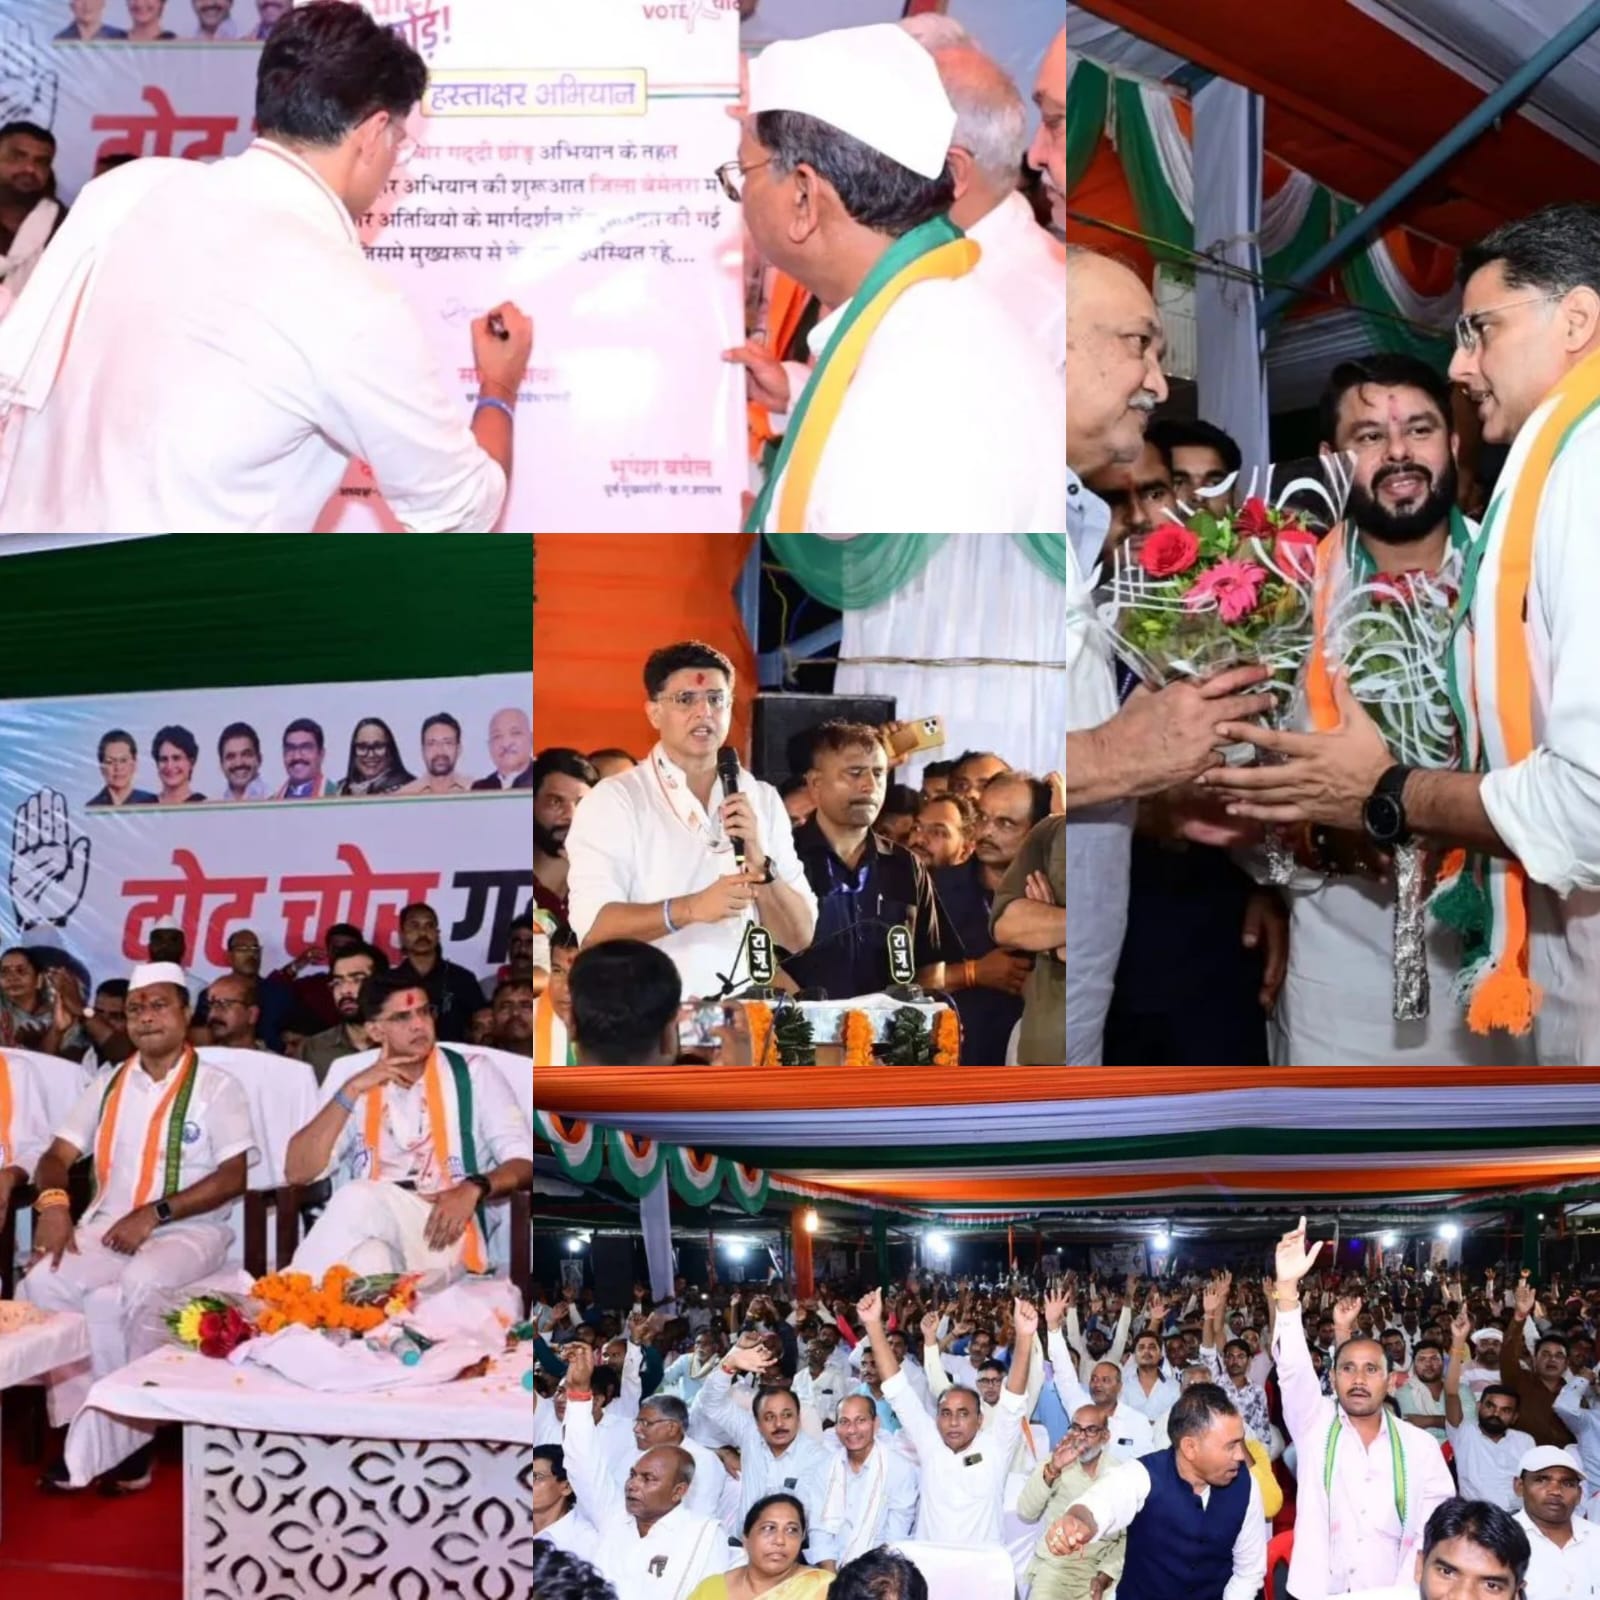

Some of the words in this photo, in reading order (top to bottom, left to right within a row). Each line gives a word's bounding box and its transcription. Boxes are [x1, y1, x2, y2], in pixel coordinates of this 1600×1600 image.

[642, 4, 689, 19] VOTE
[430, 82, 528, 110] हस्ताक्षर
[535, 73, 637, 107] अभियान
[540, 140, 614, 160] अभियान
[618, 141, 638, 160] के
[641, 144, 679, 162] तहत
[403, 174, 478, 194] अभियान
[482, 172, 507, 194] की
[462, 207, 482, 228] के
[486, 206, 564, 229] मार्गदर्शन
[409, 246, 483, 268] मुख्यरूप
[486, 241, 502, 261] से
[121, 849, 268, 969] वोट
